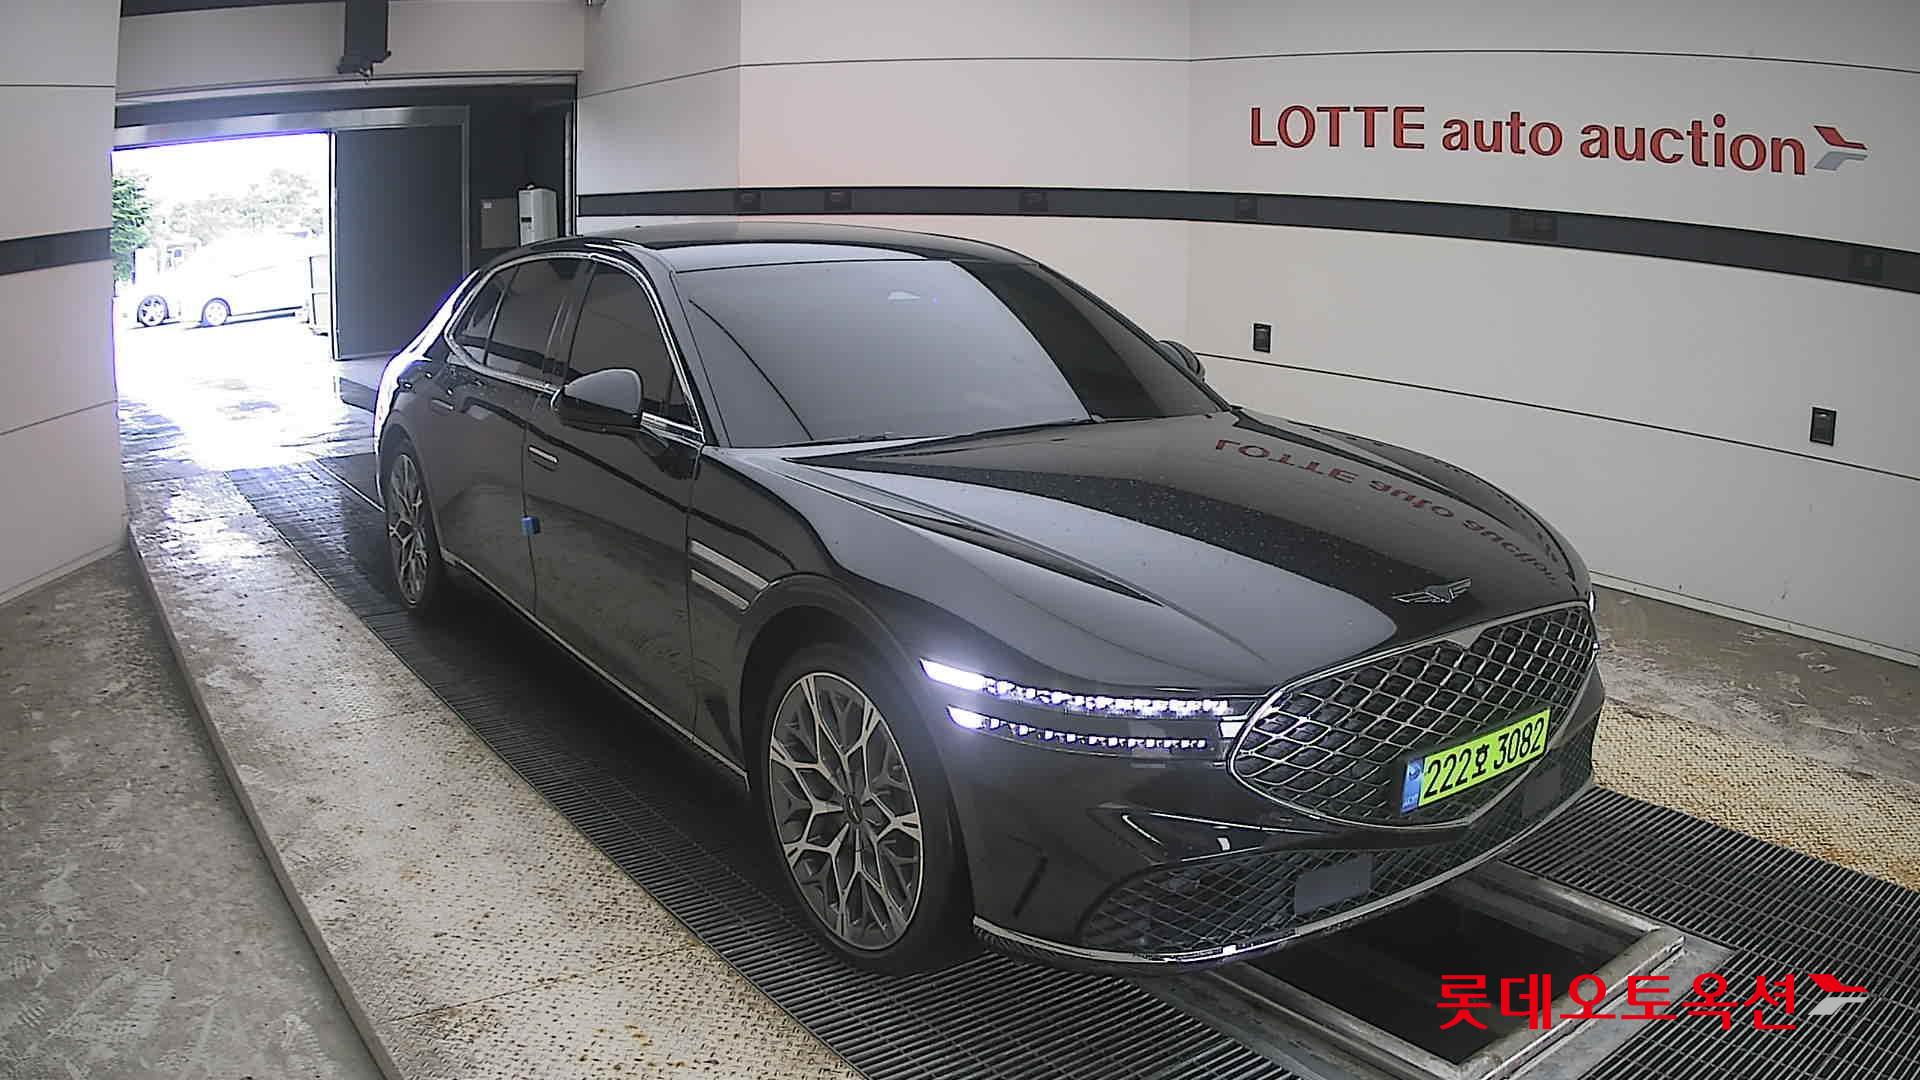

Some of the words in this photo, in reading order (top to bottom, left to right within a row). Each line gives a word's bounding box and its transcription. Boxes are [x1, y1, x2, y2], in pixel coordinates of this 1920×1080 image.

[1250, 105, 1425, 150] LOTTE
[1441, 111, 1563, 157] auto
[1579, 113, 1807, 176] auction
[1493, 717, 1545, 770] 3082
